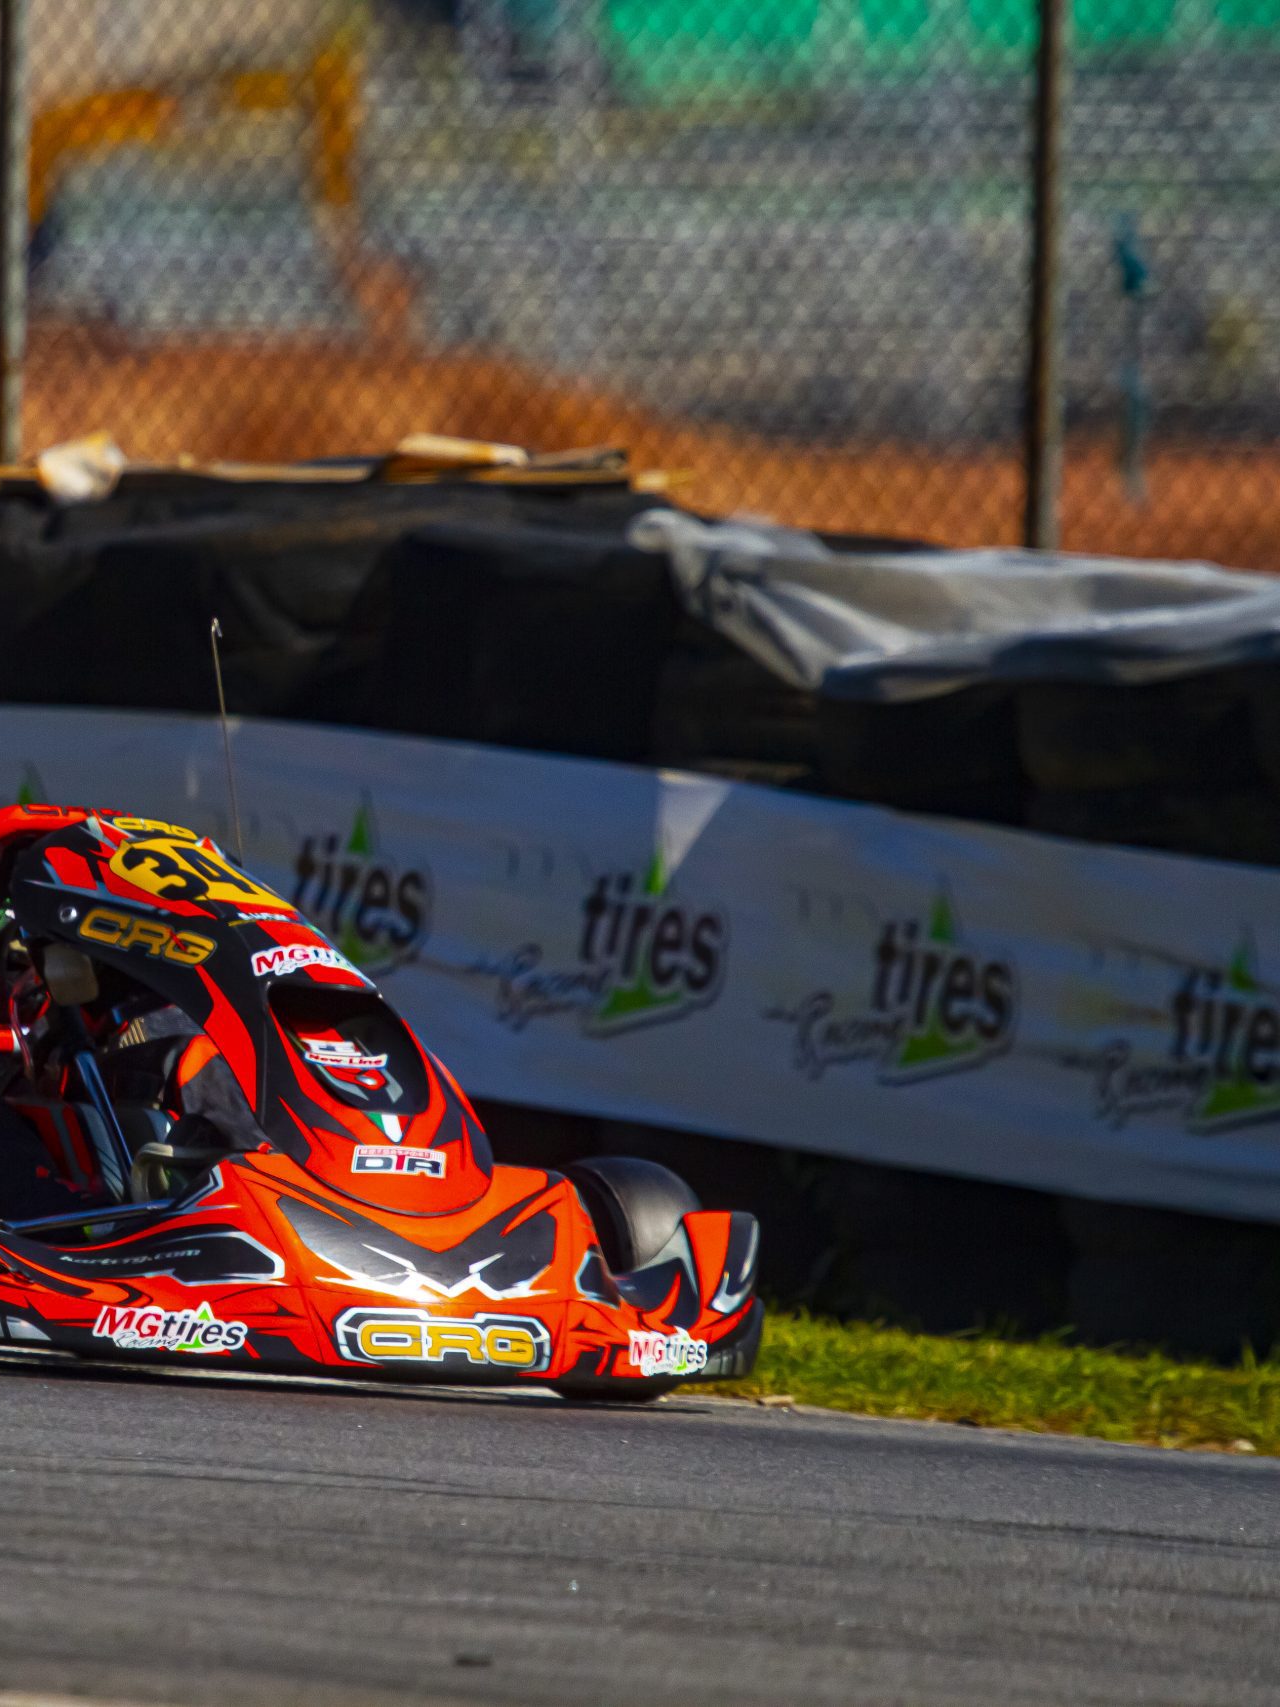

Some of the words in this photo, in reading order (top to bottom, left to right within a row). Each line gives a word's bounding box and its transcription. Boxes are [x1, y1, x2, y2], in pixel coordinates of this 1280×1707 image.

[294, 834, 427, 946] tires
[579, 872, 721, 992] tires
[80, 909, 217, 965] CRG
[871, 919, 1013, 1040] tires
[96, 1307, 244, 1347] MGtires
[360, 1323, 535, 1364] CRG
